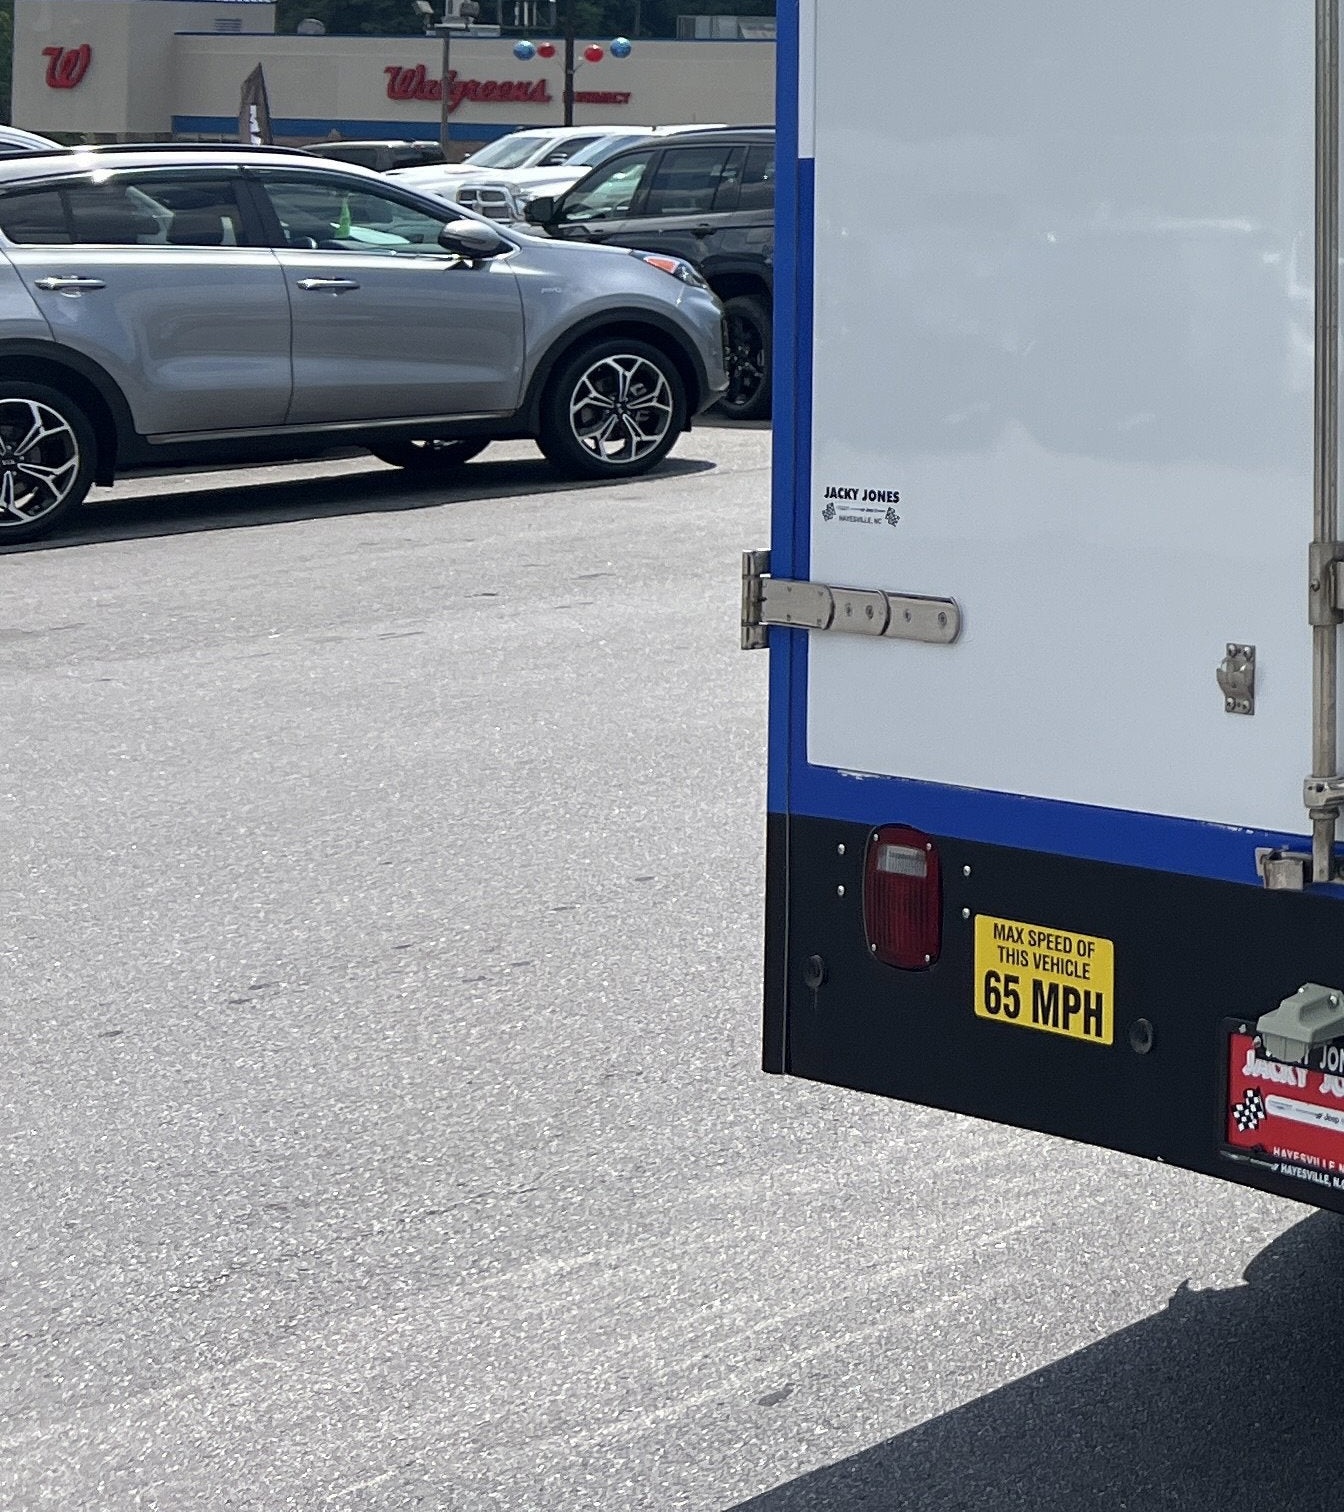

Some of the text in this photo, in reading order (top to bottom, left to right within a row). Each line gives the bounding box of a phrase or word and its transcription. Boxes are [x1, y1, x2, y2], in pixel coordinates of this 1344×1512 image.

[384, 64, 552, 114] Walgreens
[824, 486, 900, 503] JACKY JONES
[993, 922, 1096, 959] MAX SPEED OF
[997, 945, 1091, 980] THIS VEHICLE
[984, 969, 1103, 1038] 65 MPH
[1280, 1163, 1332, 1187] HAYESVILLE,
